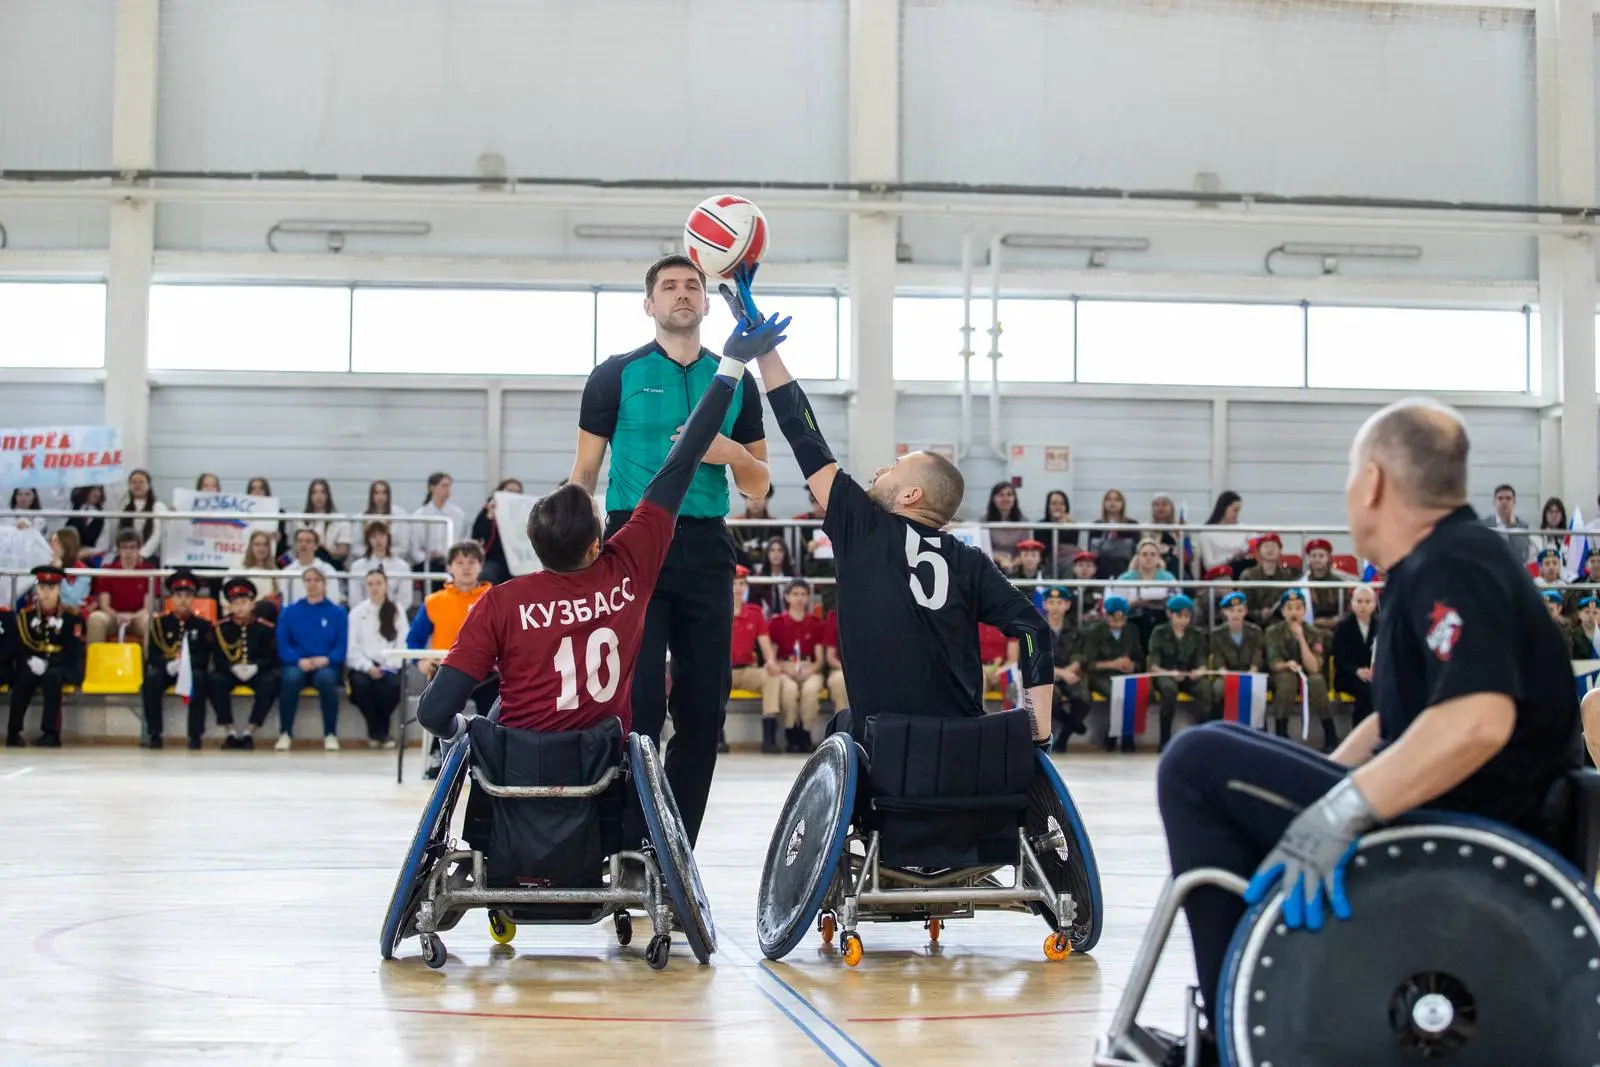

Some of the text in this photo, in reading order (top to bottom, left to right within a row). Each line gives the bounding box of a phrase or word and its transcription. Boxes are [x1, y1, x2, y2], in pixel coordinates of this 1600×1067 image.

[0, 432, 71, 450] ПЕРЁД
[21, 450, 123, 469] К ПОБЕДЕ
[905, 523, 949, 610] 5
[519, 577, 635, 630] КУЗБАСС
[553, 627, 620, 711] 10
